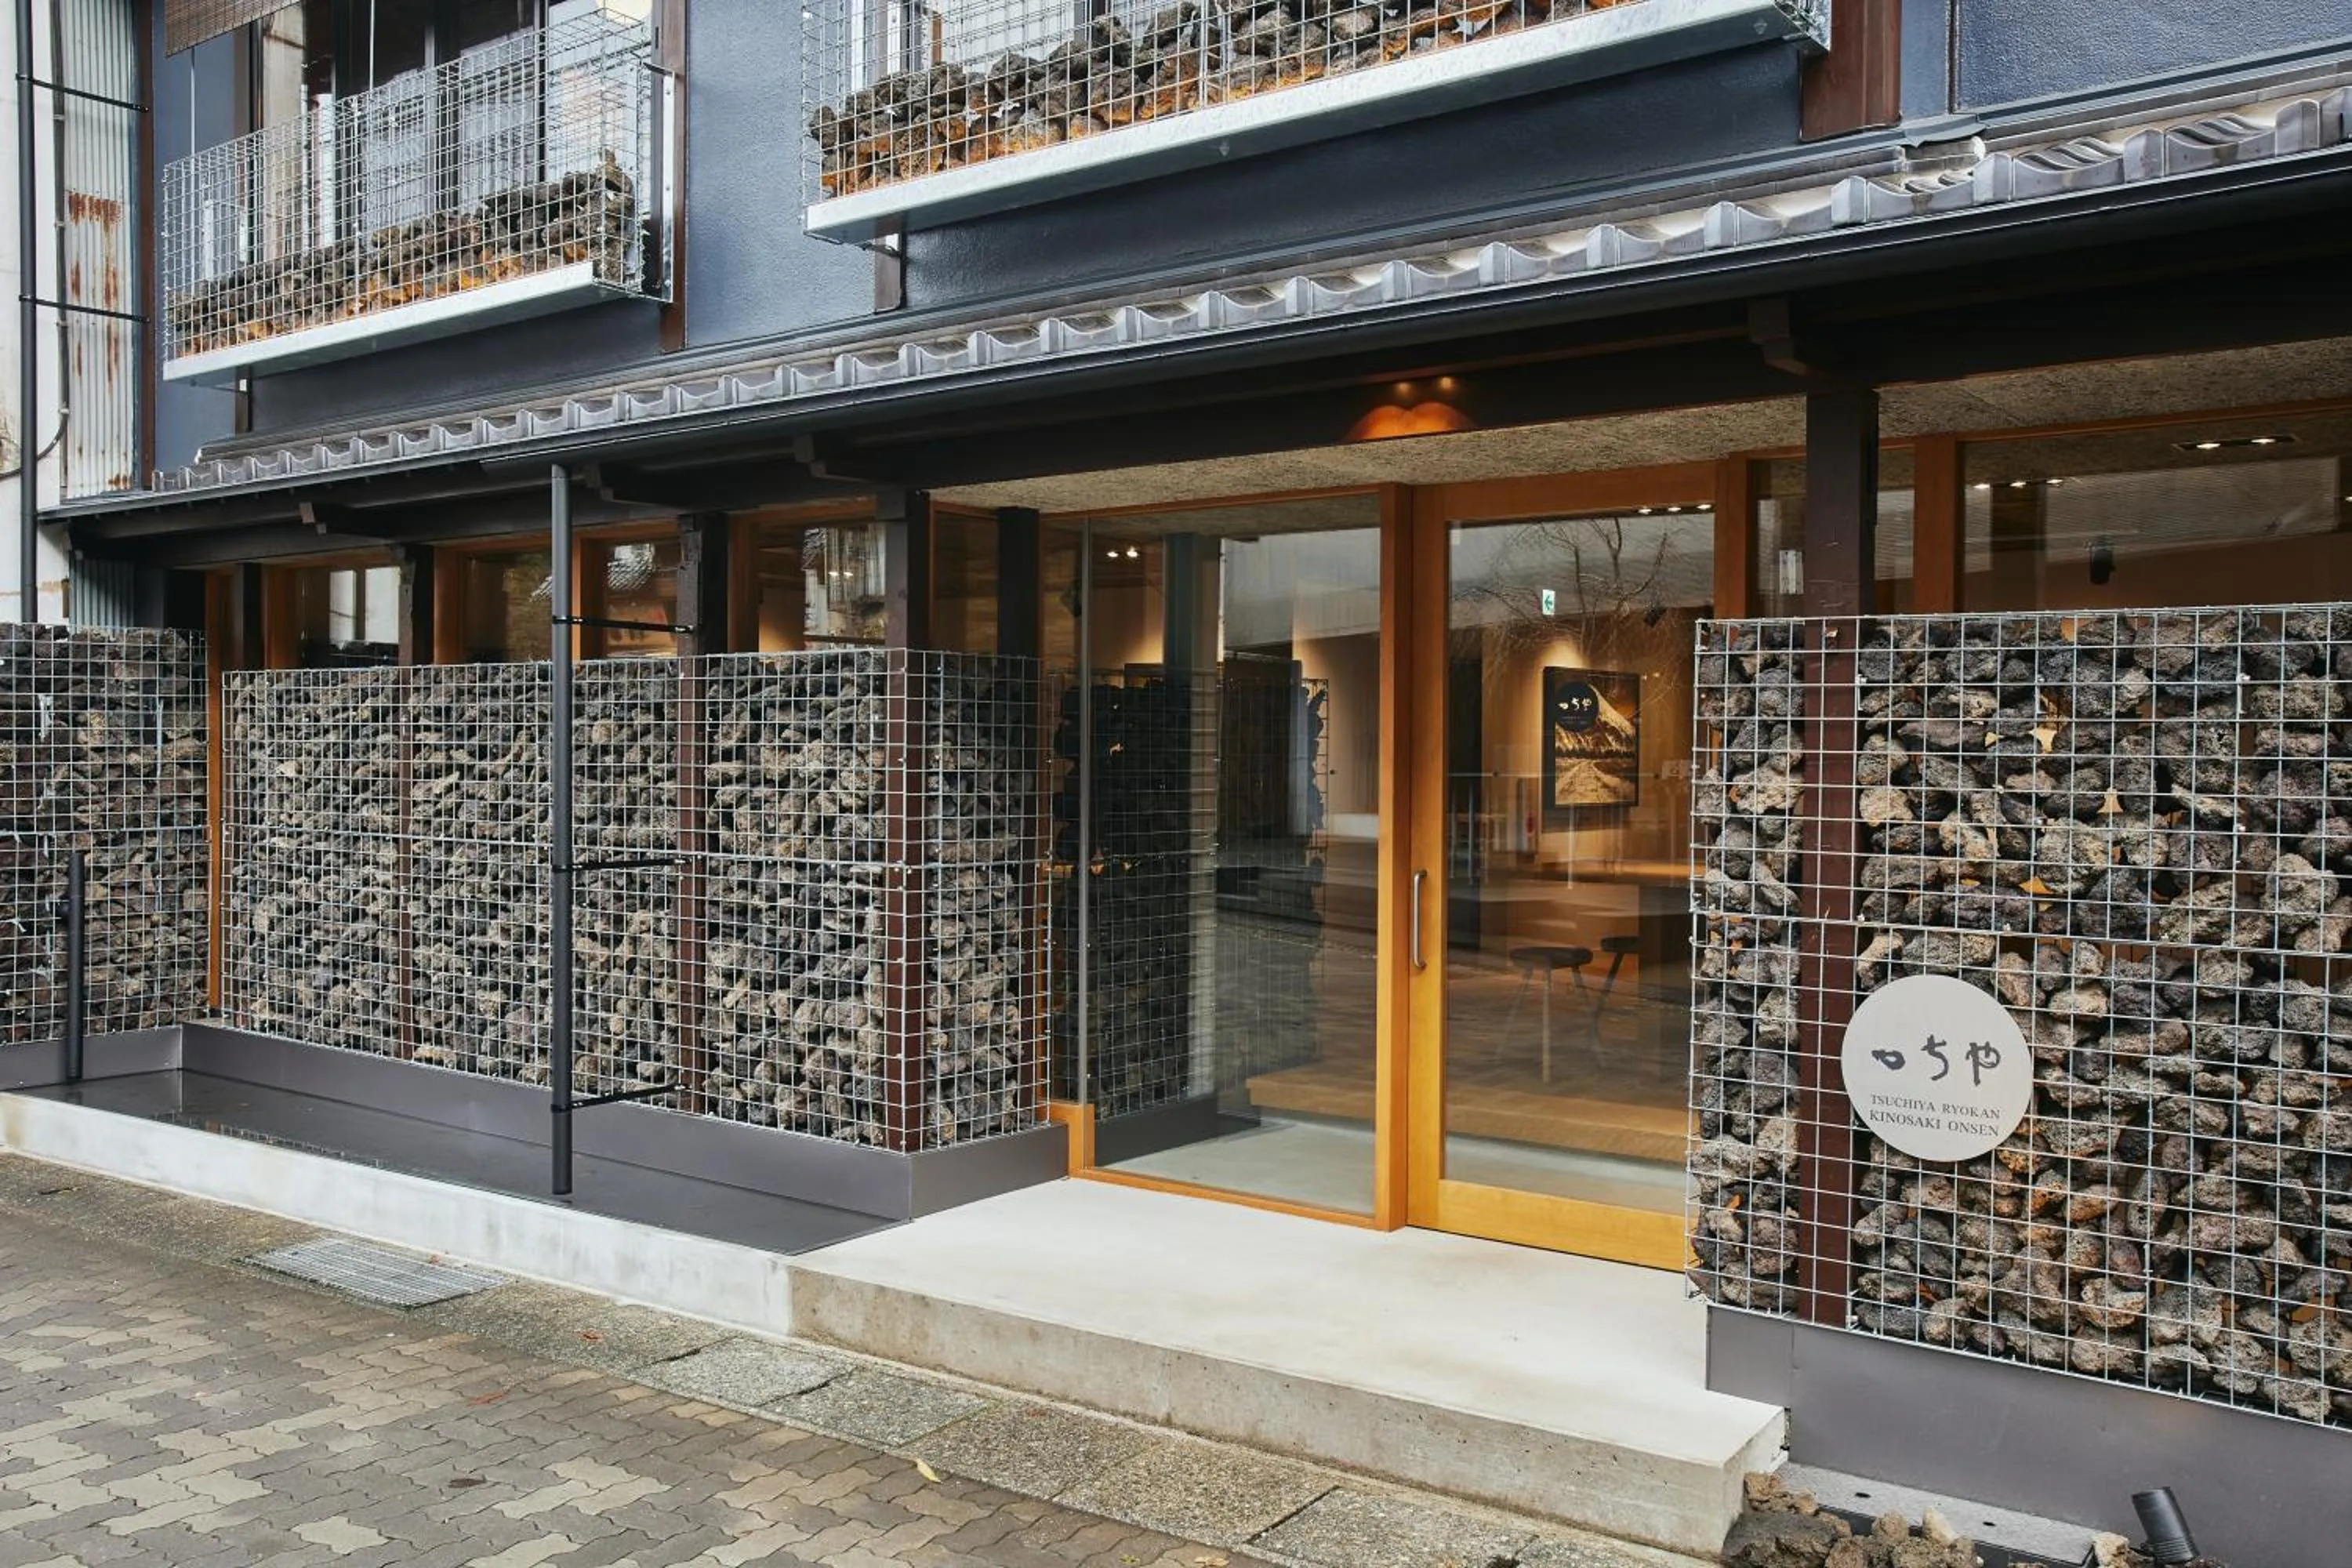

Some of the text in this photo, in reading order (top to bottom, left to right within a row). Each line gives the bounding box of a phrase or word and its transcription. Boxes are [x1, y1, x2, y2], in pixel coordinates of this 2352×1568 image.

[1871, 1094, 2000, 1120] TSUCHIYA RYOKAN
[1869, 1109, 1999, 1137] KINOSAKI ONSEN
